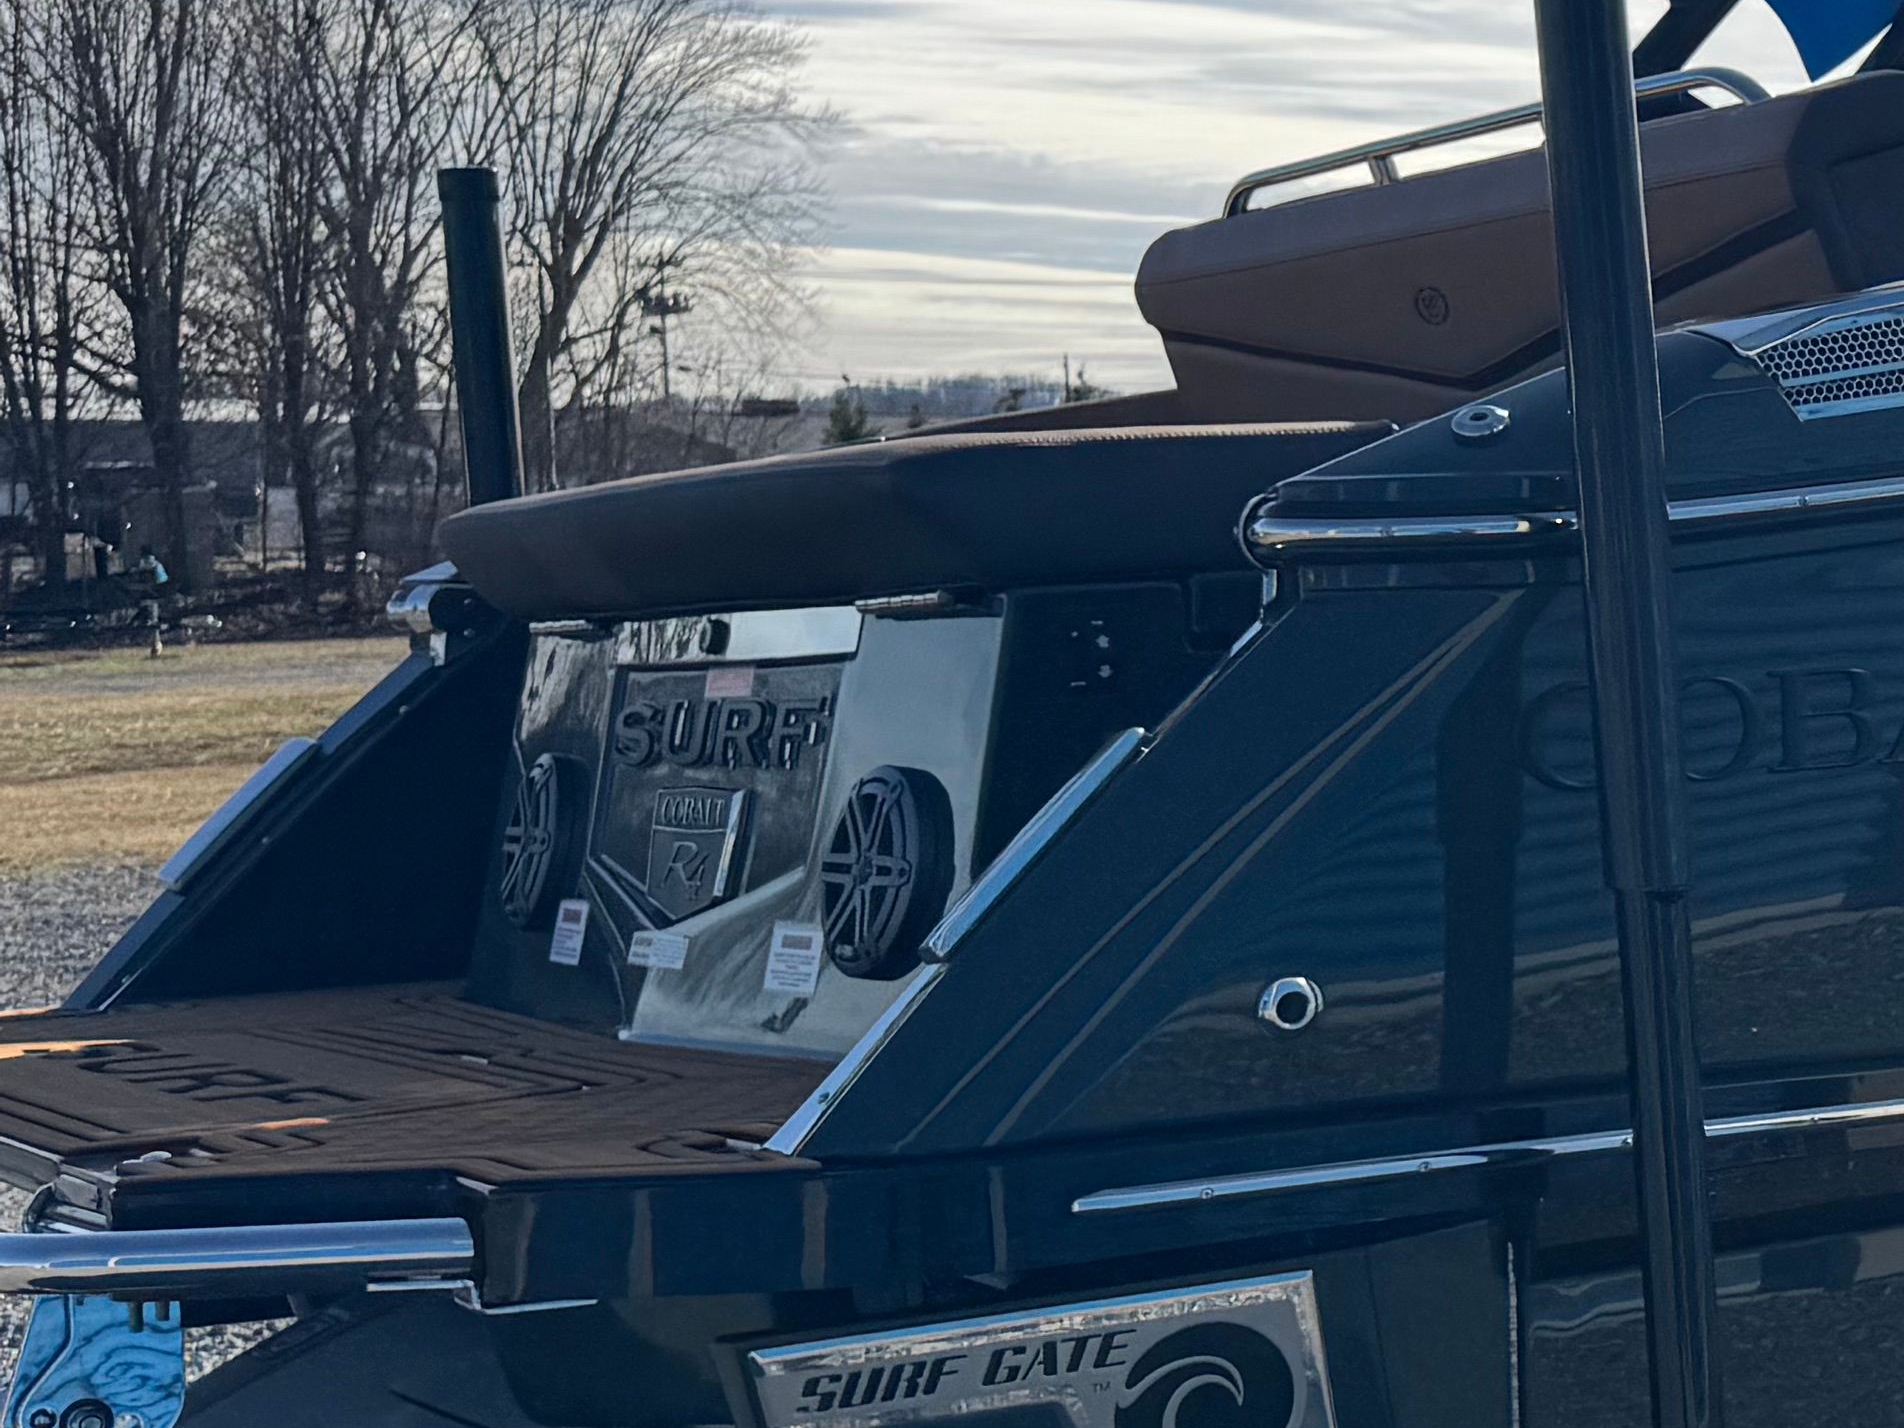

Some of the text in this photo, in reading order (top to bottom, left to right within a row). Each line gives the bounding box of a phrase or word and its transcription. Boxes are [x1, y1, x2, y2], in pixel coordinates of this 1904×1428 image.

[614, 694, 832, 771] SURF
[661, 795, 726, 825] COBALT
[661, 840, 711, 901] R4
[796, 1329, 1137, 1414] SURF GATE
[1091, 1382, 1112, 1395] TM
